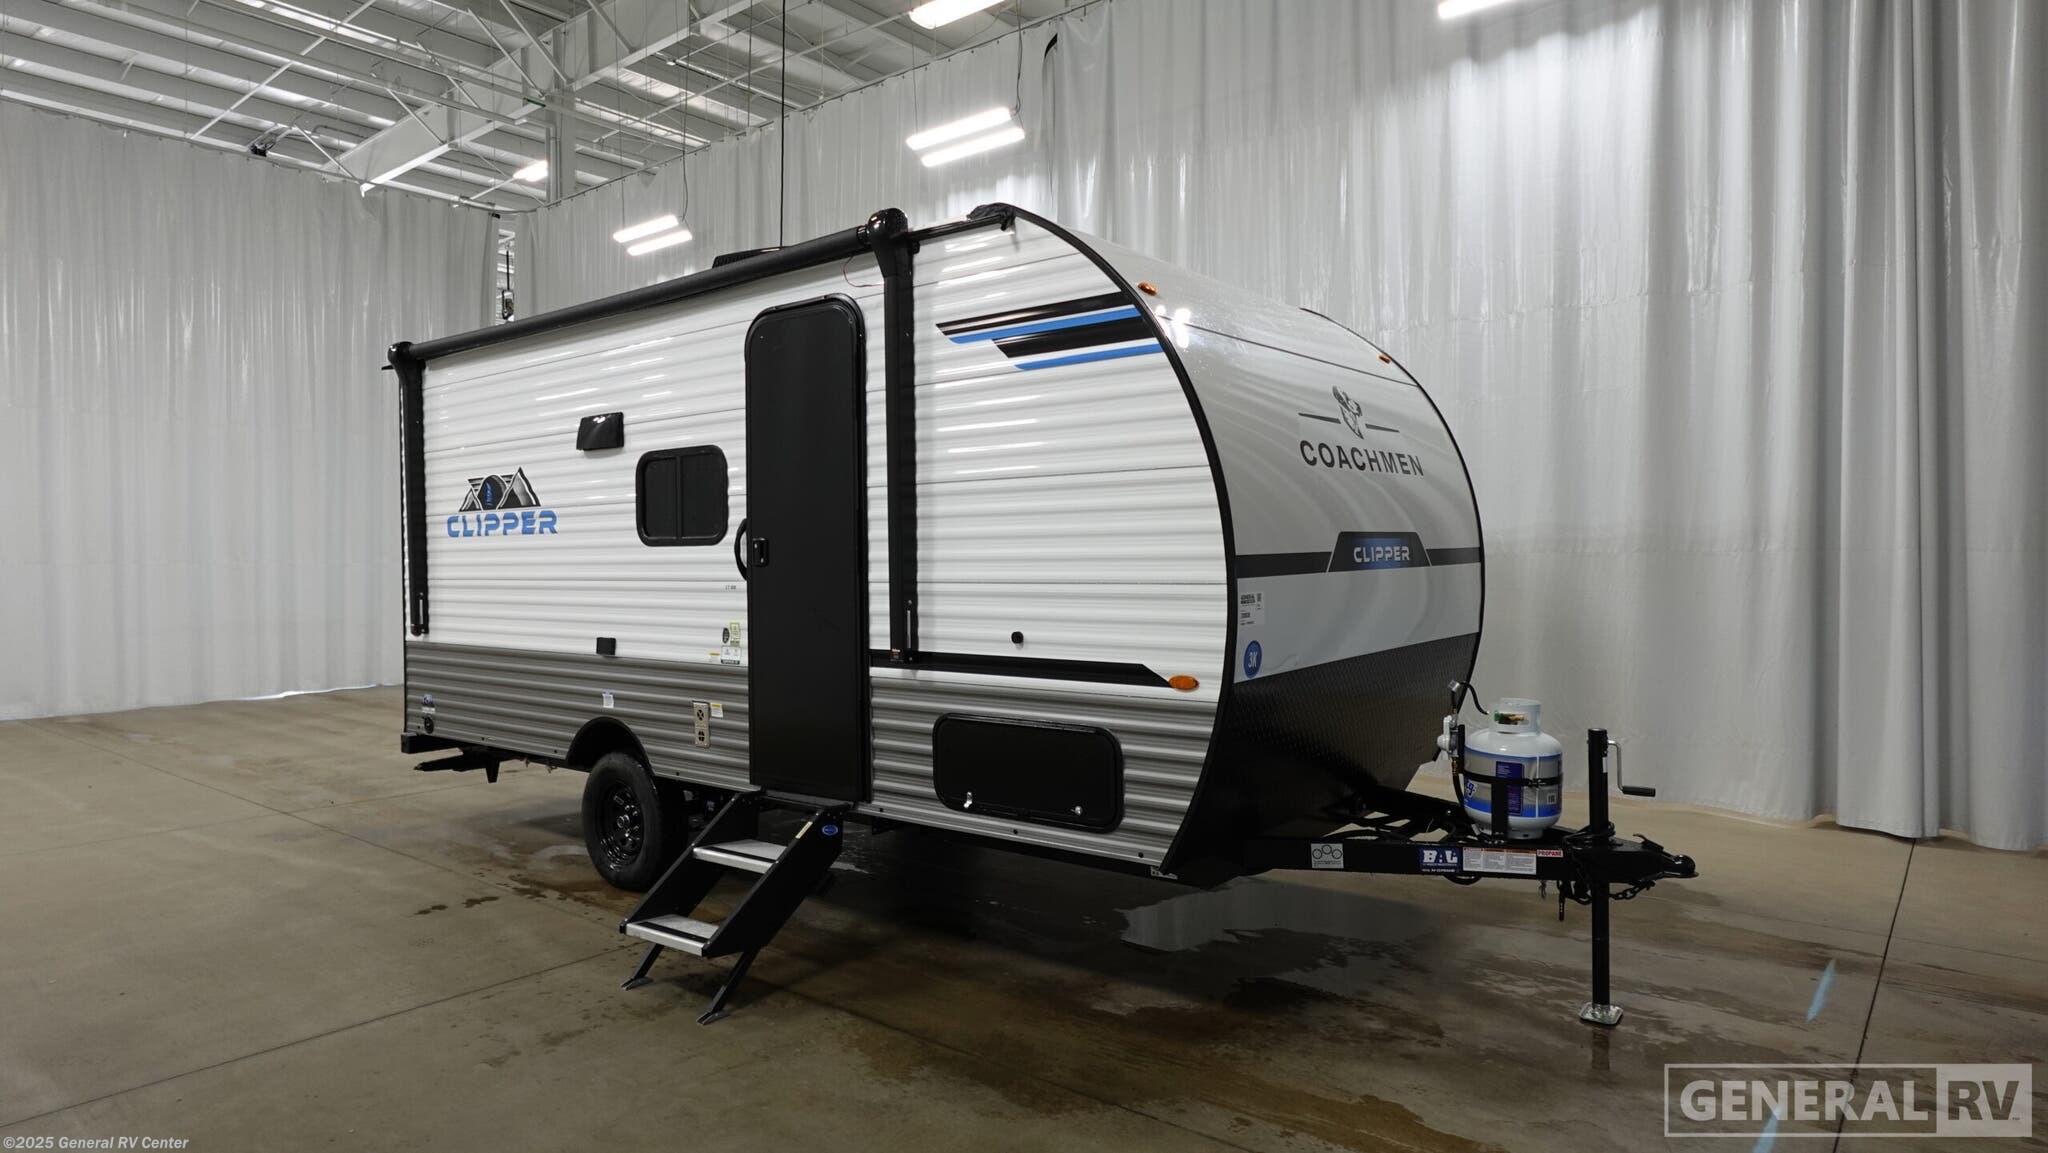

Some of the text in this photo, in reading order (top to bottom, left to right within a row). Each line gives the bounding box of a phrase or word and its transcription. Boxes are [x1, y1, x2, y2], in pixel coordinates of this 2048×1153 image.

[1300, 440, 1424, 476] COACHMEN
[447, 510, 558, 538] CLIPPER
[1353, 546, 1410, 563] CLIPPER
